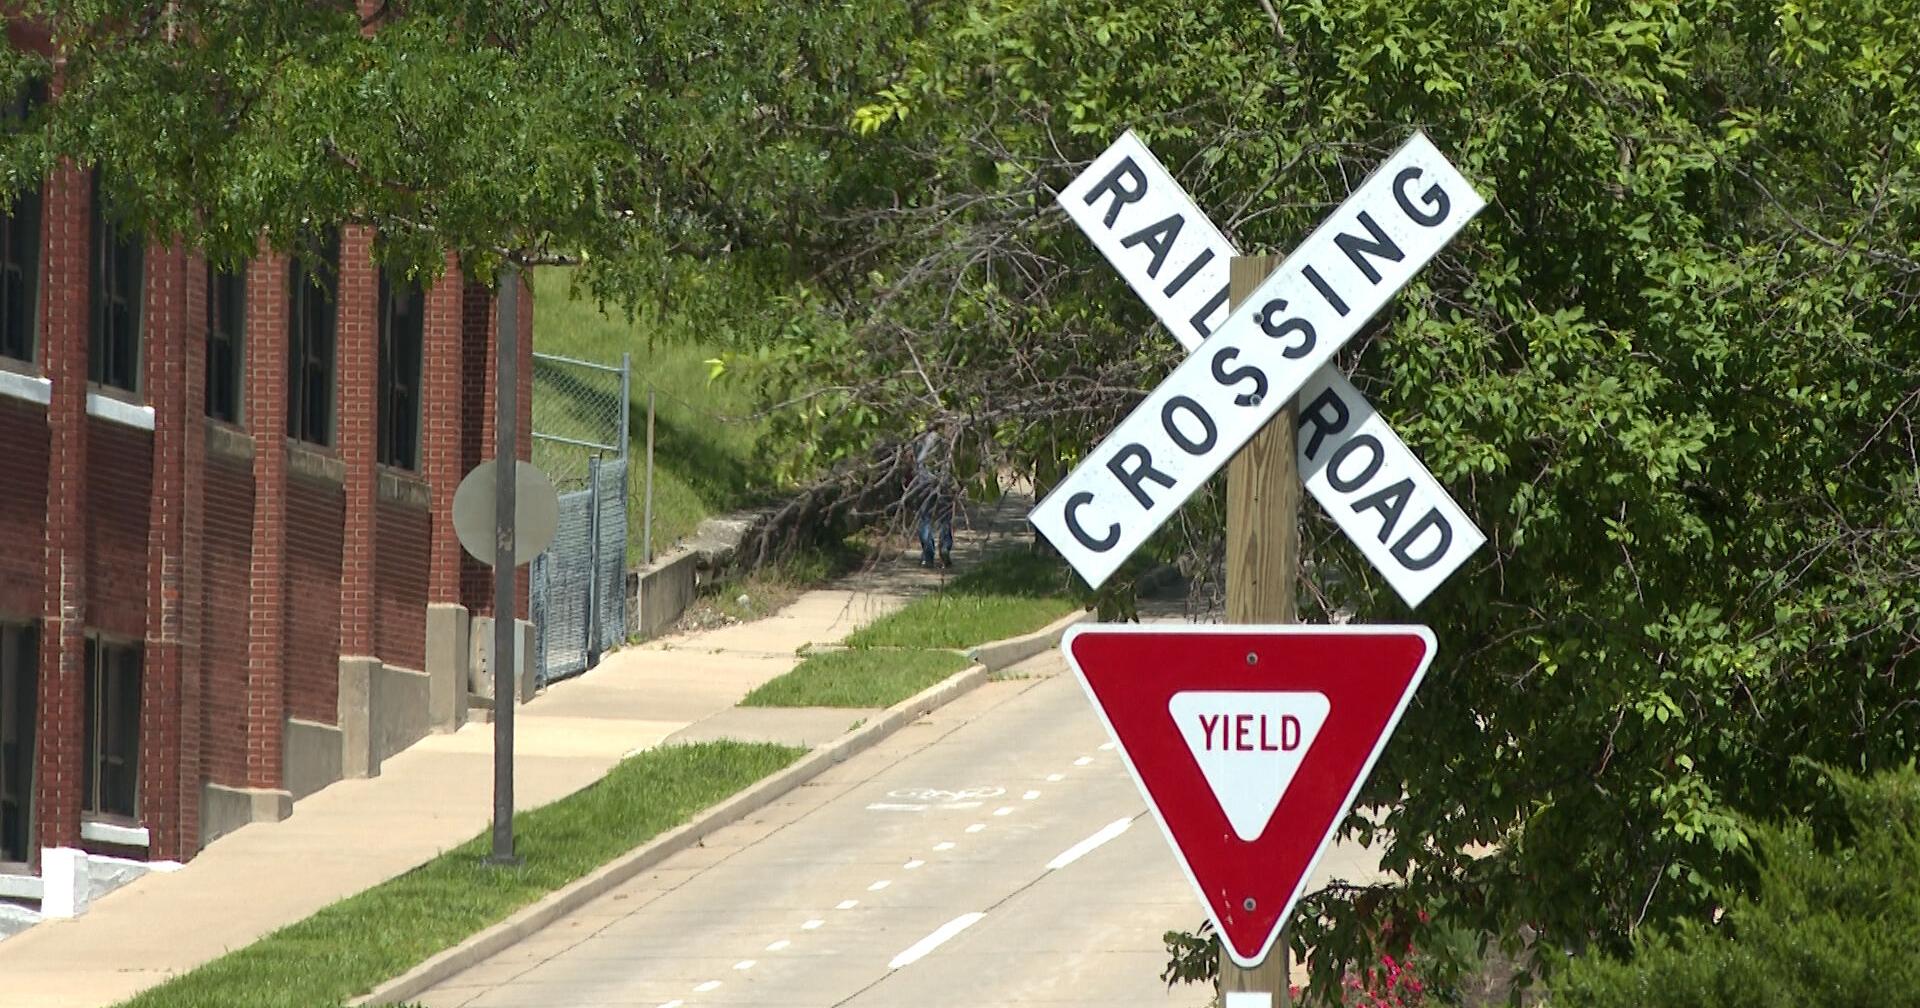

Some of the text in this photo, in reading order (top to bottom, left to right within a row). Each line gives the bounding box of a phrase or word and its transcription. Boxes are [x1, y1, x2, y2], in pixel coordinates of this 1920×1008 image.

[1064, 166, 1451, 553] CROSSING
[1083, 156, 1453, 571] RAIL ROAD
[1199, 714, 1302, 752] YIELD
